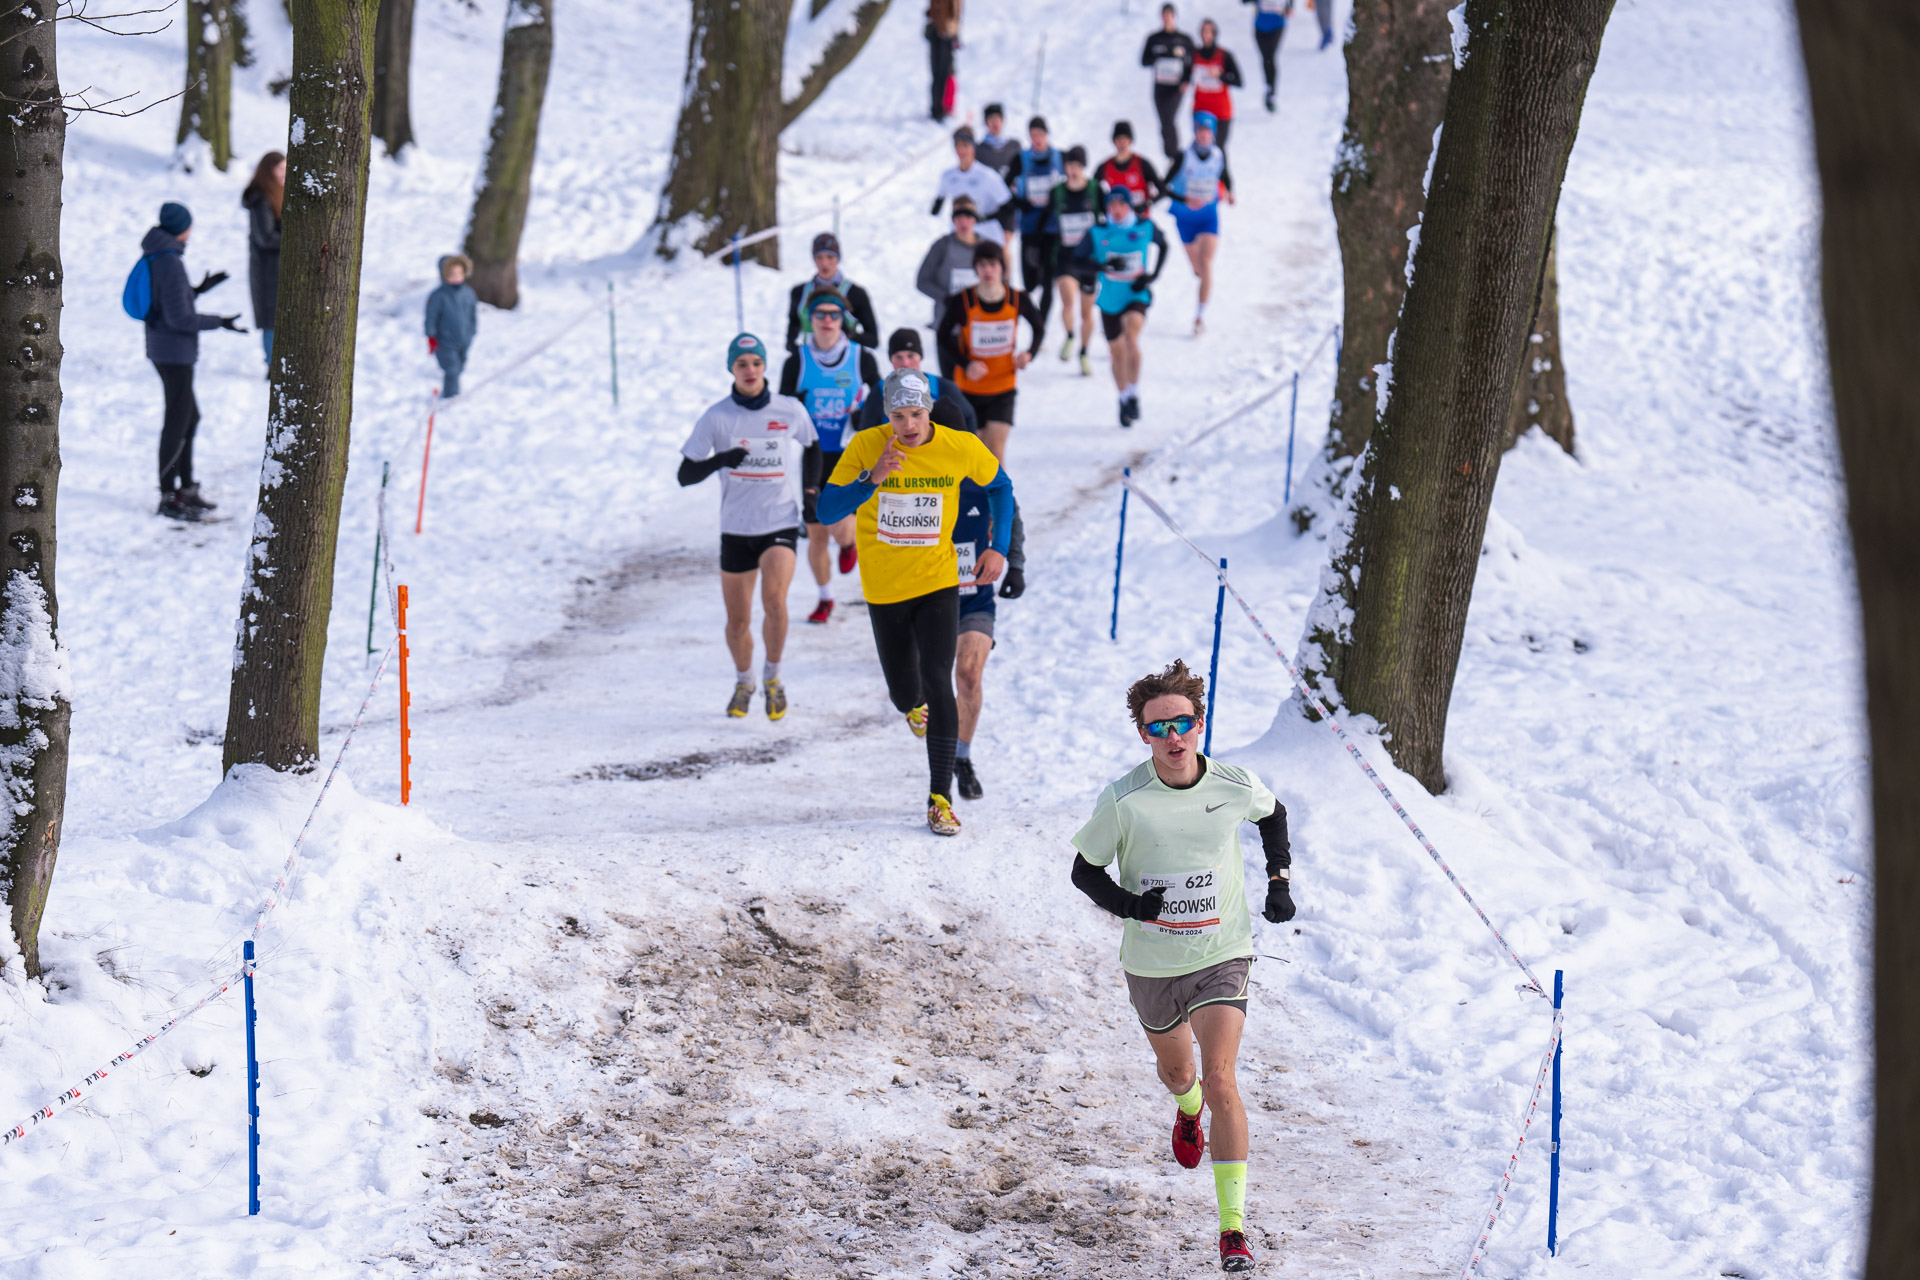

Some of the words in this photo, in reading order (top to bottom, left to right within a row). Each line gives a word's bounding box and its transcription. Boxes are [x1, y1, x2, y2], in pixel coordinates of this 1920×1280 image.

[914, 496, 938, 507] 178
[880, 512, 940, 528] ALEKSIŃSKI
[1150, 878, 1164, 886] 770
[1185, 873, 1213, 889] 622
[1160, 895, 1216, 915] RGOWSKI
[1159, 926, 1185, 936] BYTOM
